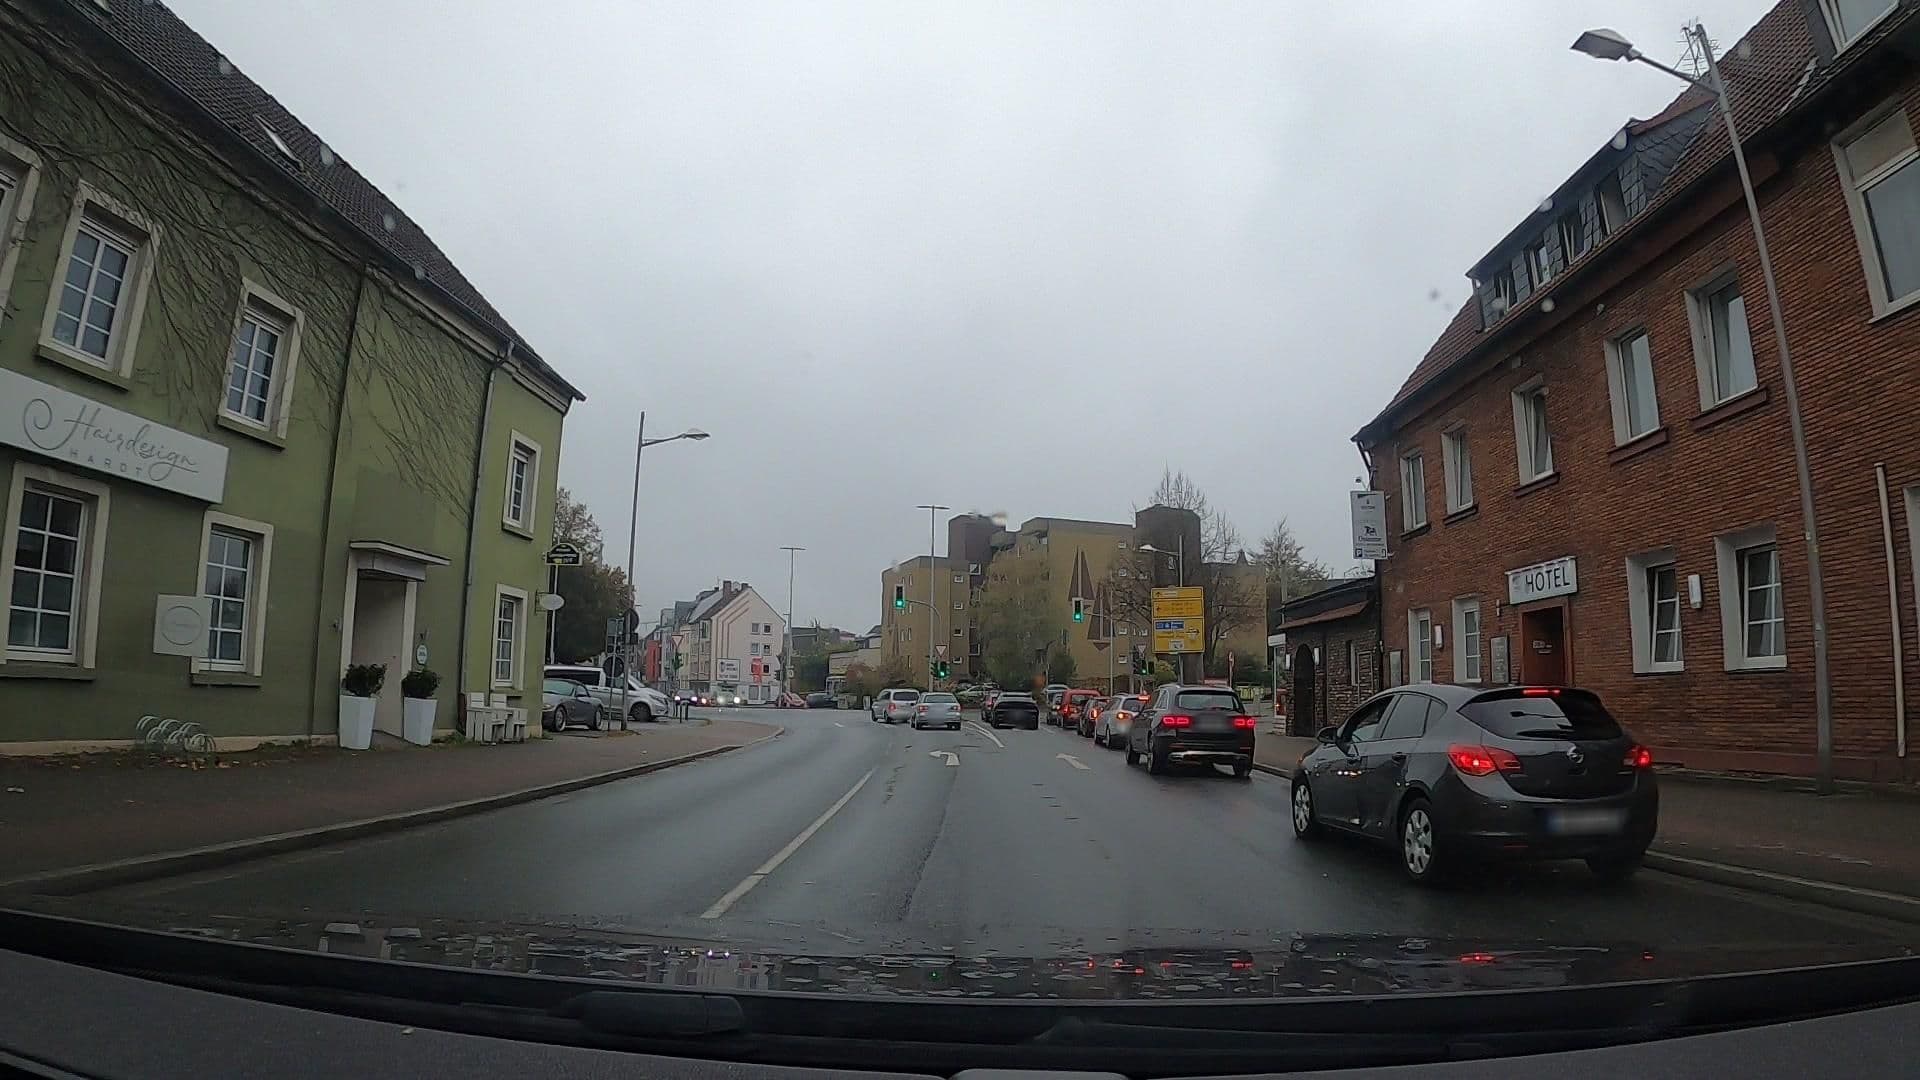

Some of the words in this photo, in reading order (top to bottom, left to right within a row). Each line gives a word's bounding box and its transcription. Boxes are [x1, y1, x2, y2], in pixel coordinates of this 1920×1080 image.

[24, 399, 198, 481] Hairdesign
[70, 449, 143, 475] HARDT
[1525, 566, 1570, 592] HOTEL
